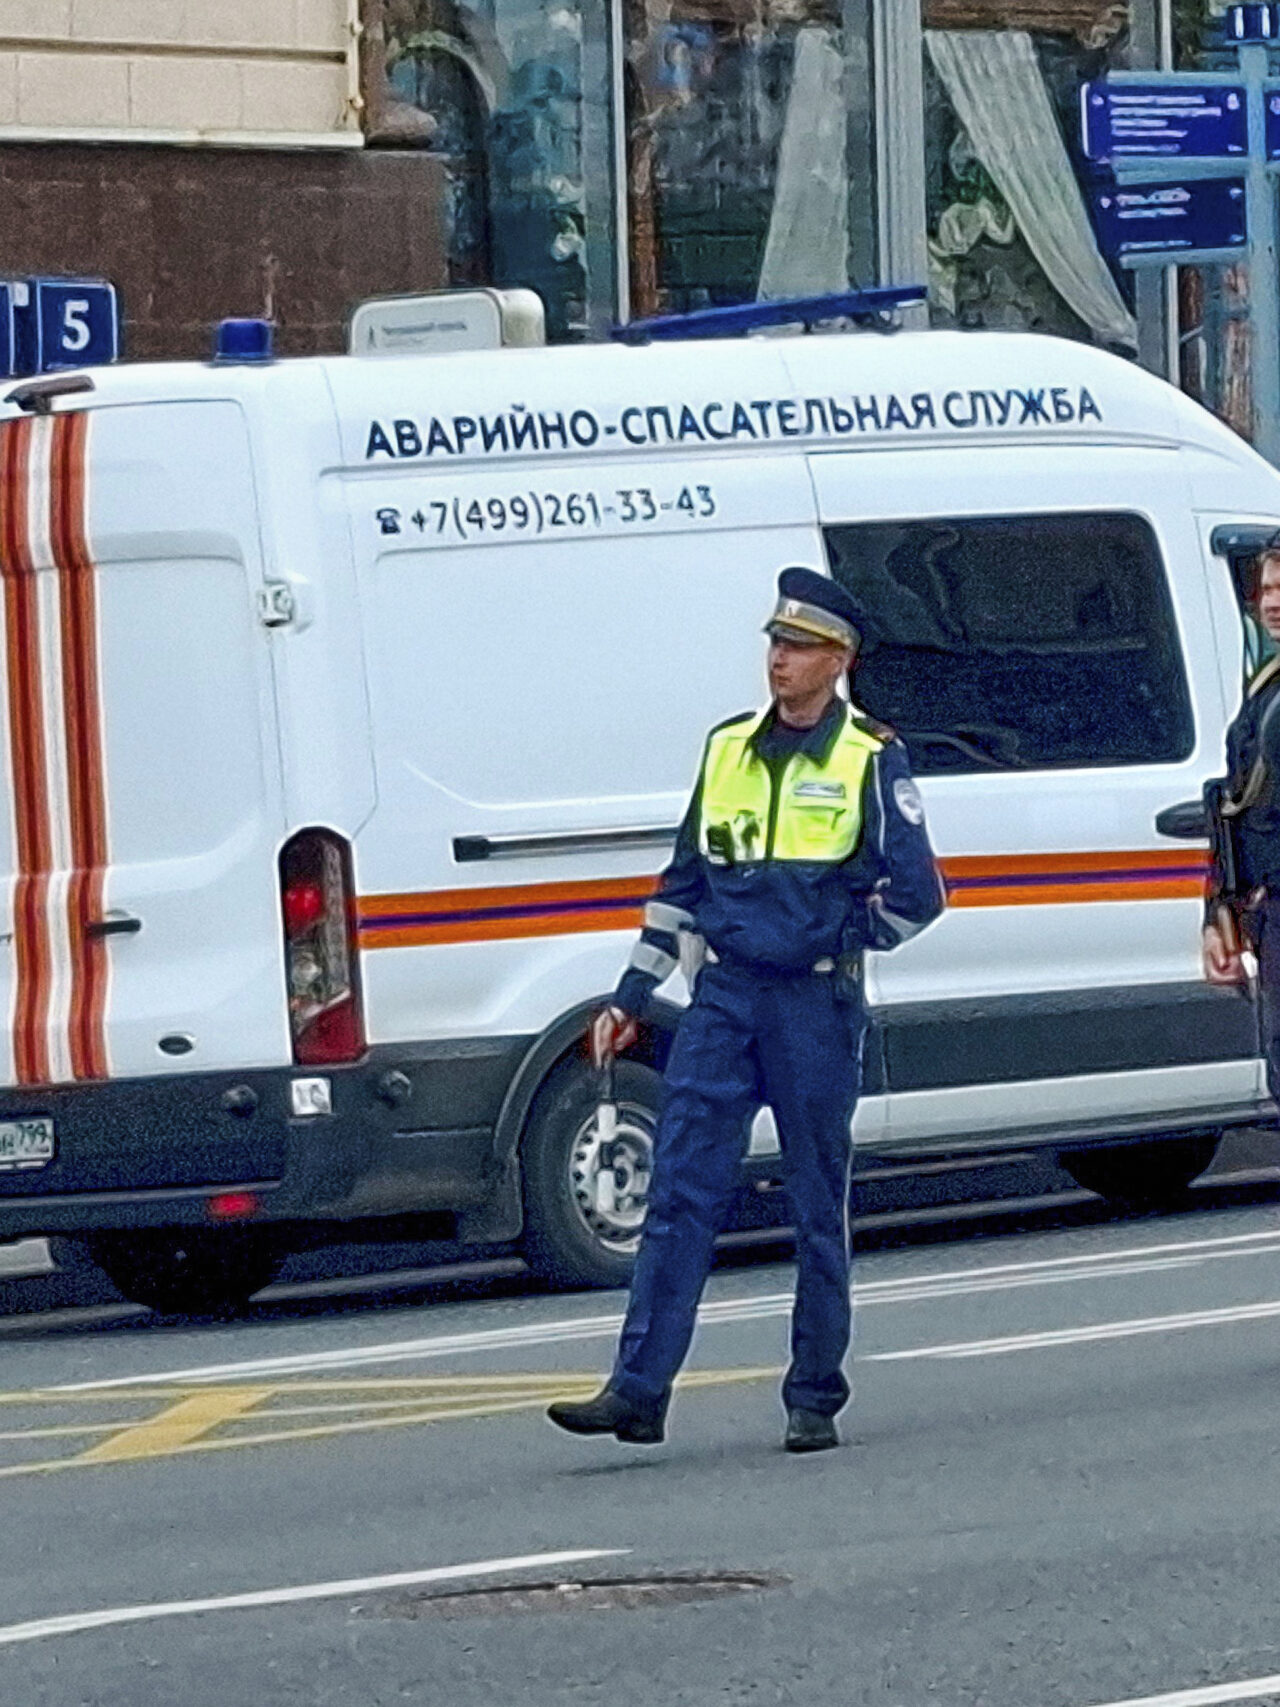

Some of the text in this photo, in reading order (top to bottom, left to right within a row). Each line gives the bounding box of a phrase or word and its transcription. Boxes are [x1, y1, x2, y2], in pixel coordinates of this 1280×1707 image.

[62, 299, 90, 351] 5
[365, 386, 1103, 459] АВАРИЙНО-СПАСАТЕЛЬНАЯ СЛУЖБА
